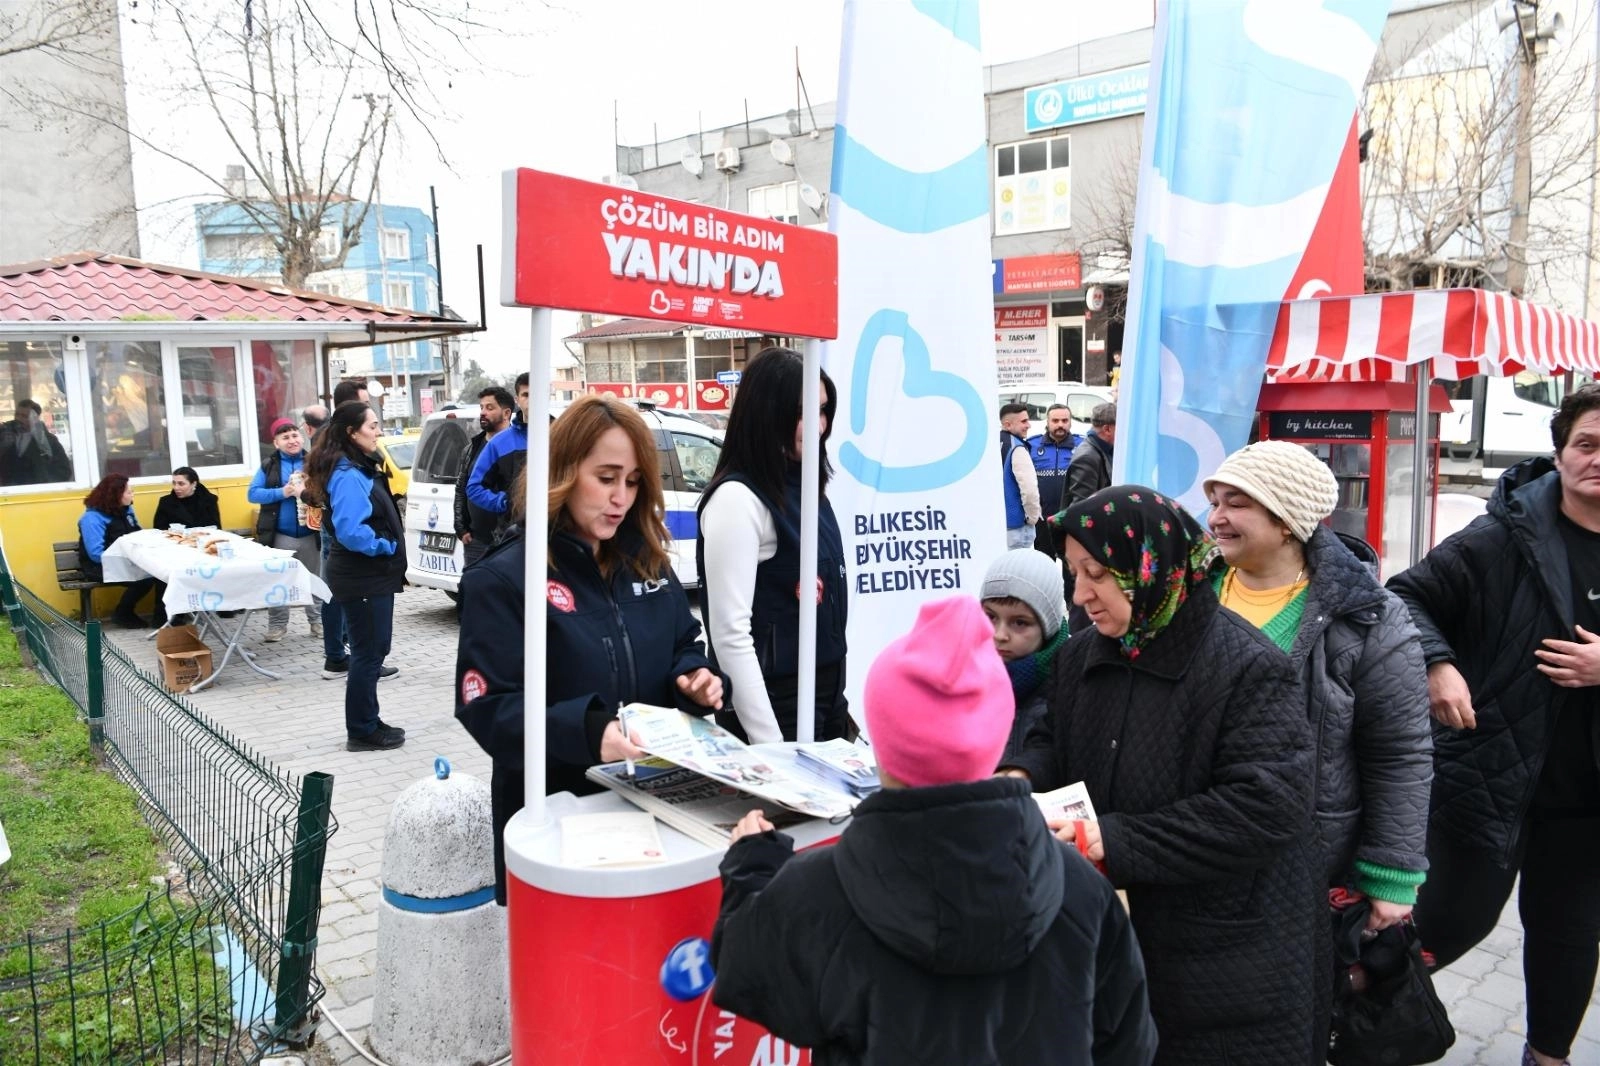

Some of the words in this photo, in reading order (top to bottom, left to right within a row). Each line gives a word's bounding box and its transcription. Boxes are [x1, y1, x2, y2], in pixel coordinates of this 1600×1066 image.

[601, 195, 688, 236] ÇÖZÜM
[694, 213, 729, 243] BİR
[733, 225, 785, 254] ADIM
[601, 232, 785, 299] YAKIN'DA
[1286, 418, 1300, 432] by
[1304, 418, 1354, 431] kitchen
[419, 553, 457, 573] ZABITA
[856, 563, 961, 594] ELEDİYESİ
